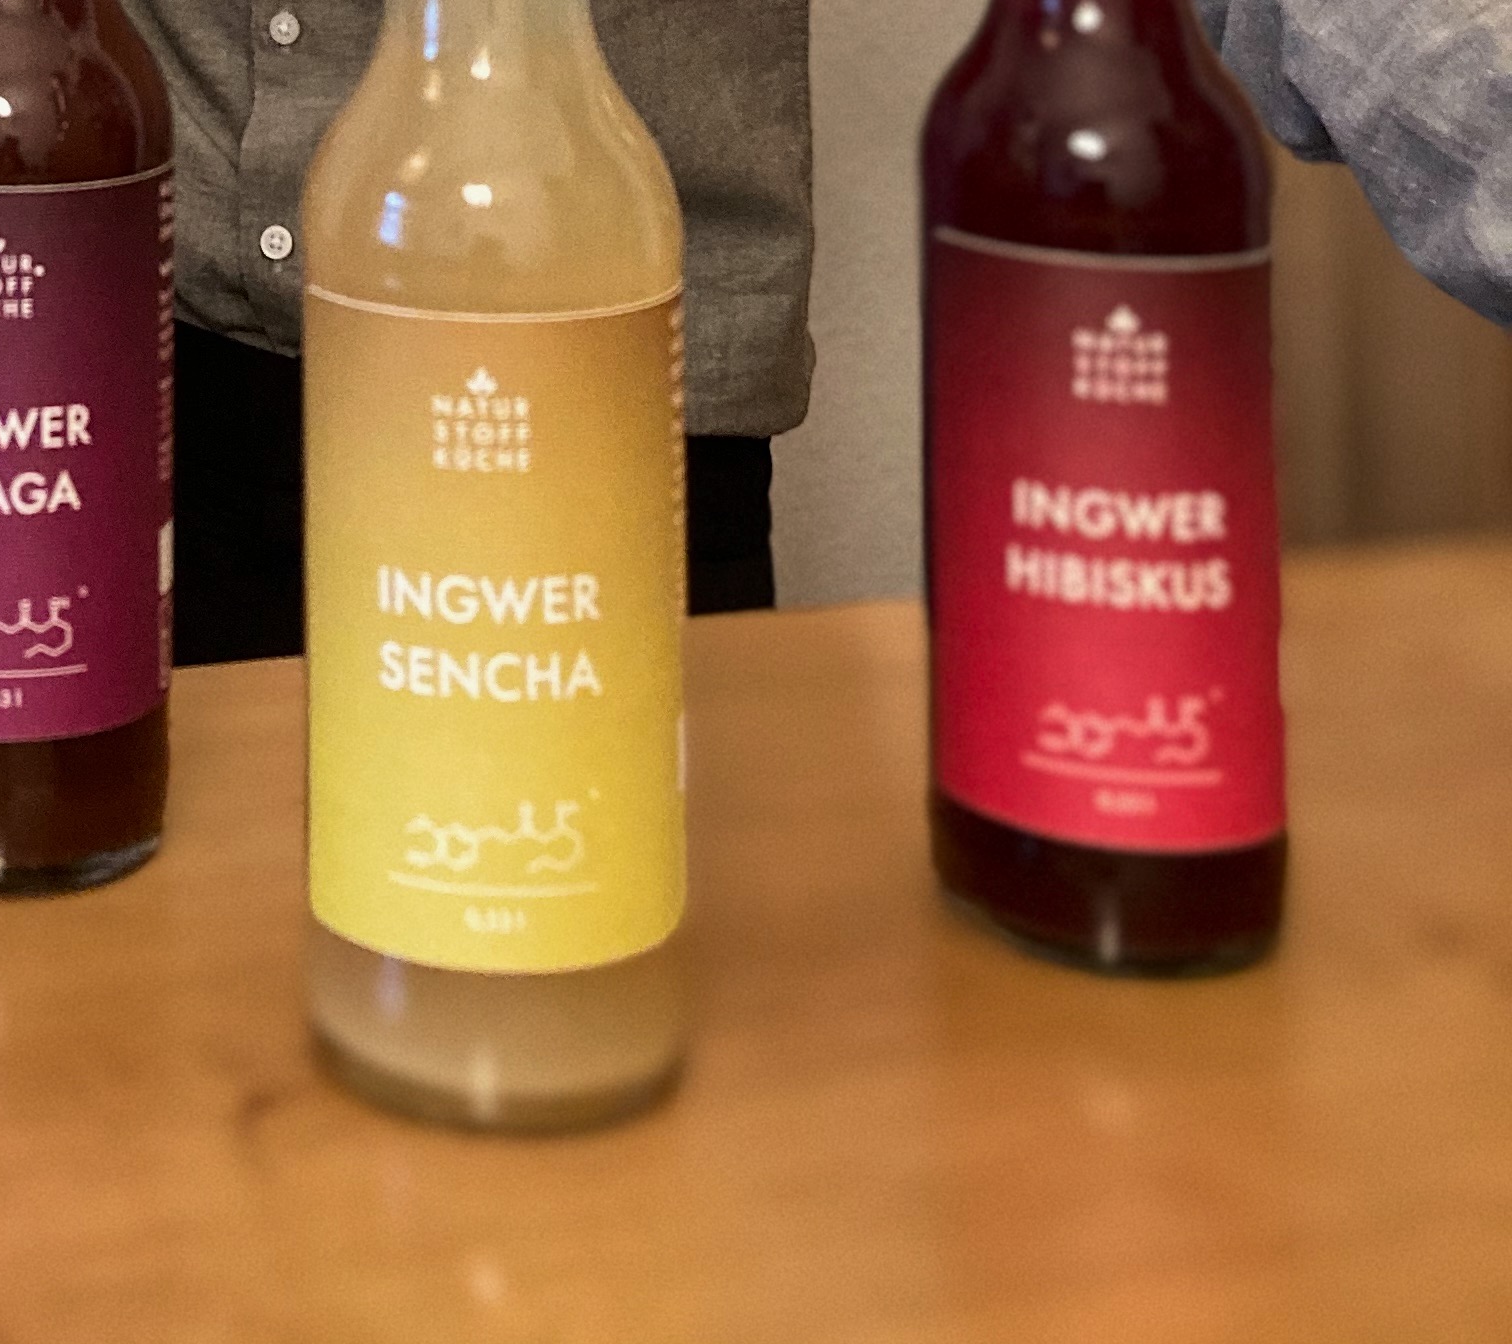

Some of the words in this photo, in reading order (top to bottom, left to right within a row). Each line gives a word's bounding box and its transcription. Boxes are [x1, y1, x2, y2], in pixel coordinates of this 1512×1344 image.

[1010, 477, 1228, 544] INGWER
[377, 564, 601, 624] INGWER
[1005, 542, 1233, 612] HIBISKUS
[378, 639, 602, 703] SENCHA
